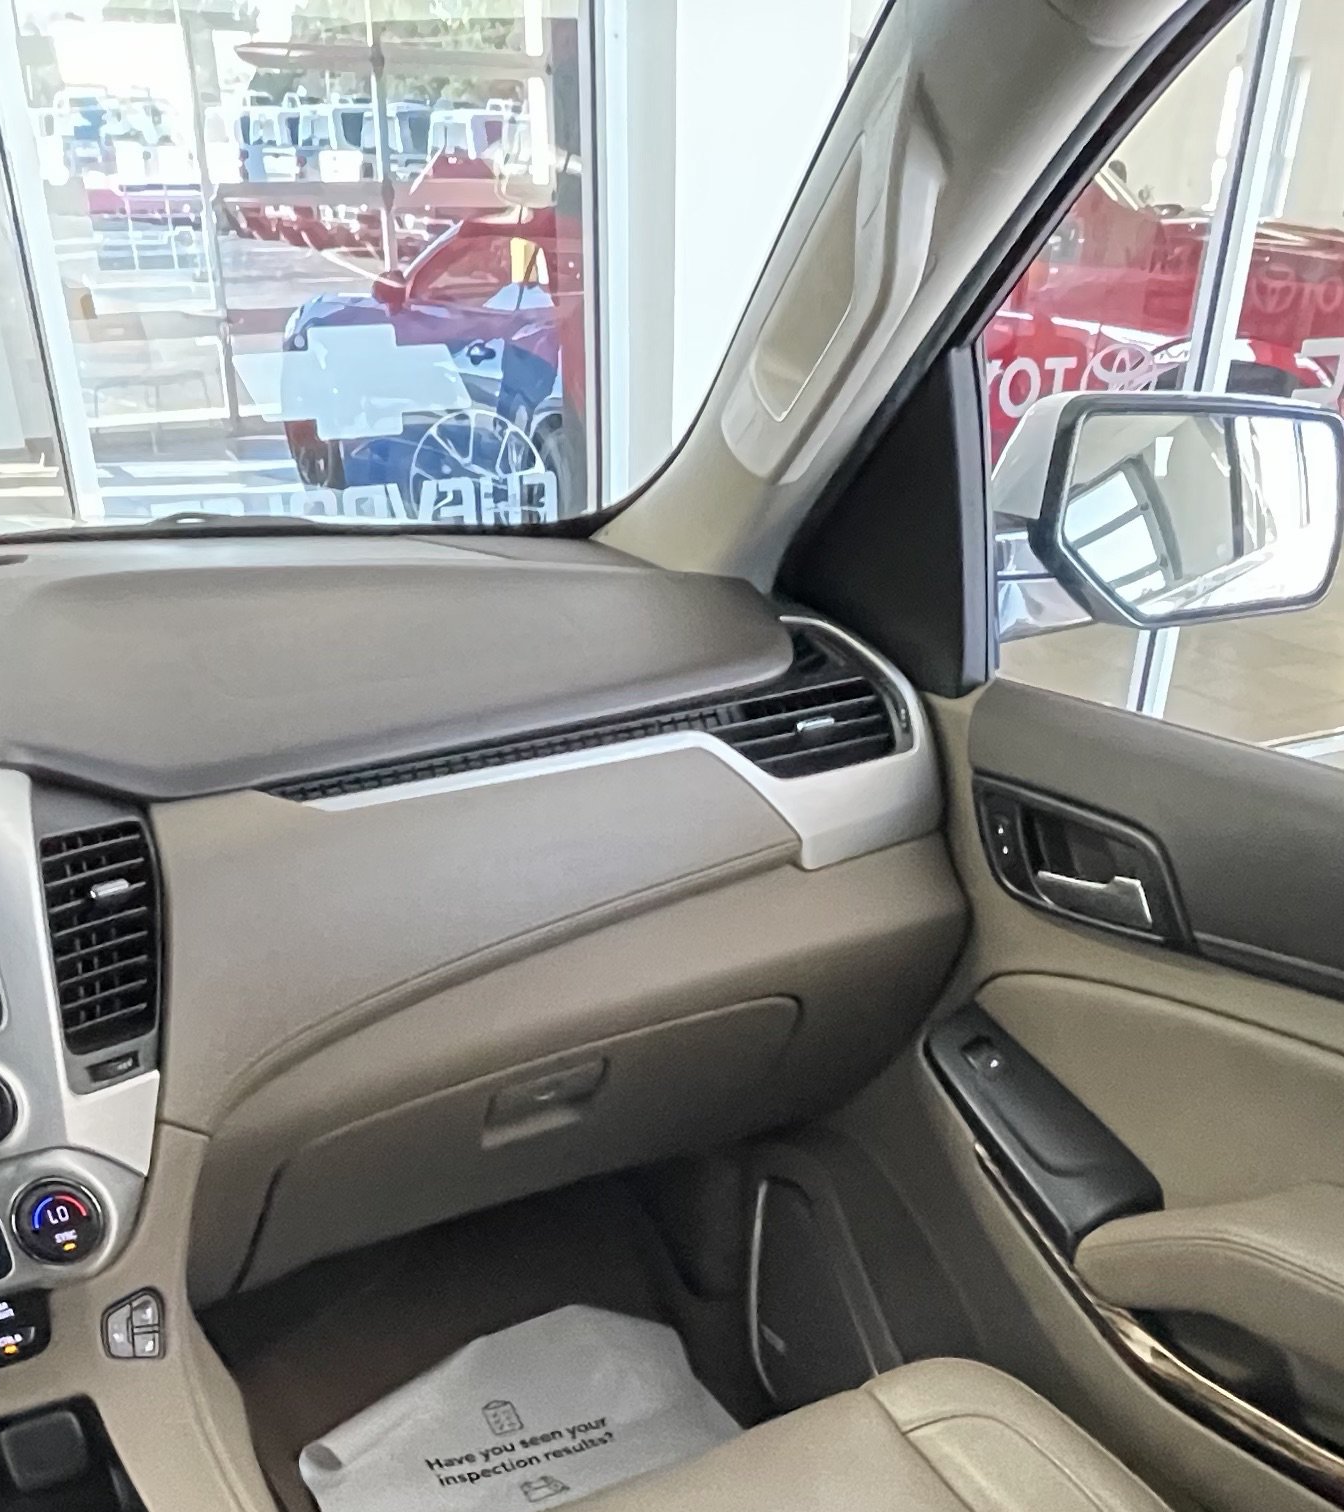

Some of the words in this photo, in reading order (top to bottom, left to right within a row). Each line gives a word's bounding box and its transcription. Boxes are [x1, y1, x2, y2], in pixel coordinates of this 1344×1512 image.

[425, 1453, 476, 1471] Have
[479, 1442, 516, 1462] you
[519, 1429, 564, 1449] seen
[566, 1416, 607, 1440] your
[437, 1456, 542, 1488] inspection
[544, 1431, 615, 1462] results?
